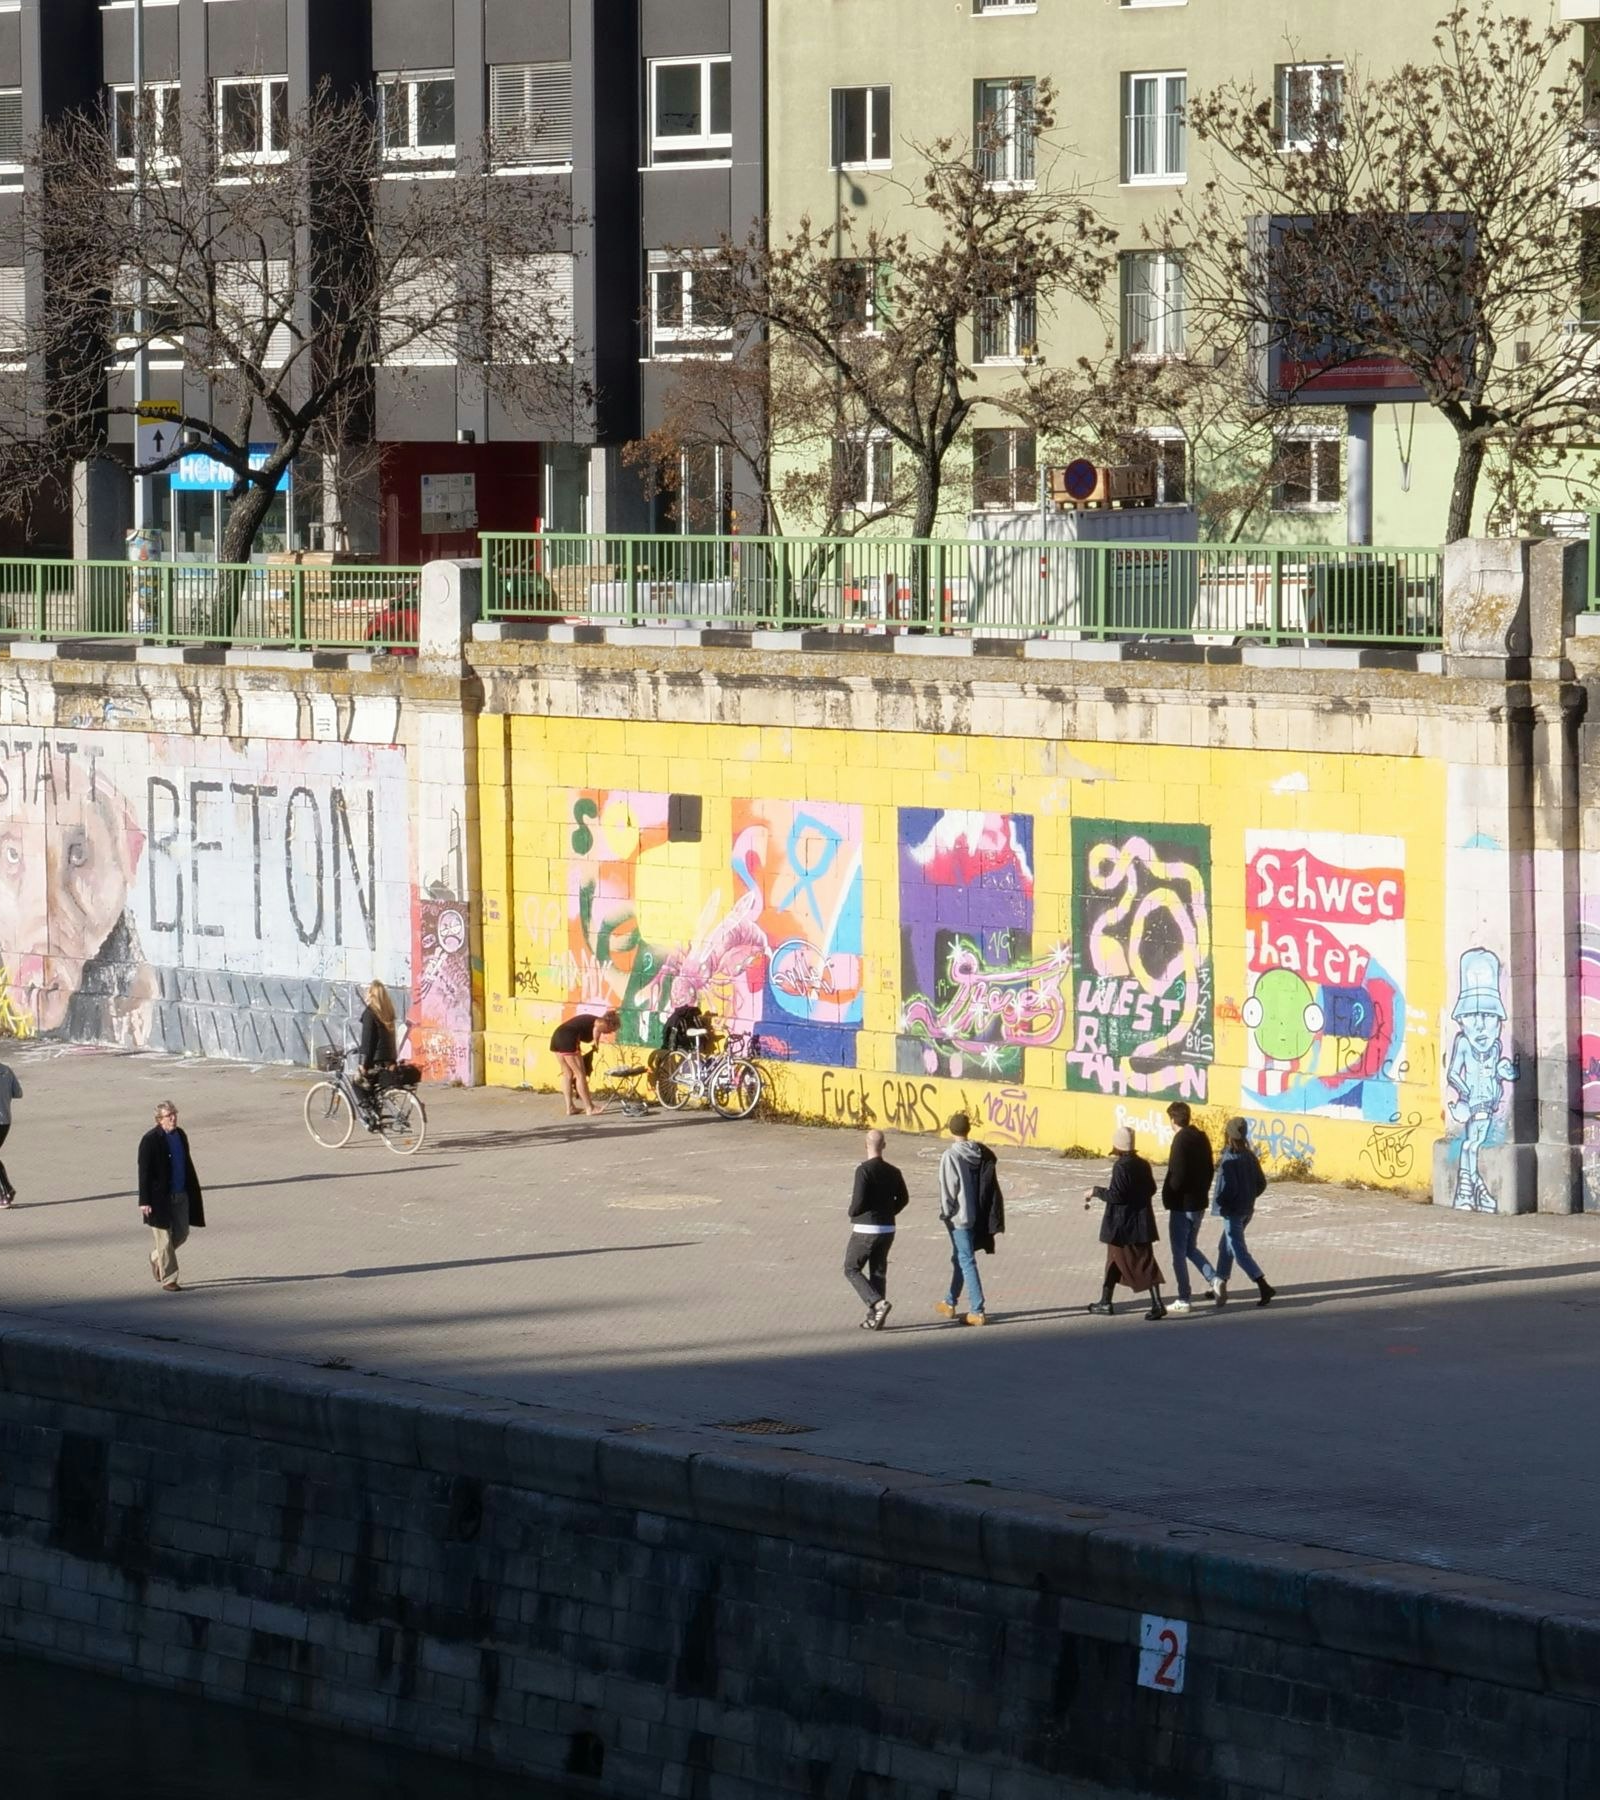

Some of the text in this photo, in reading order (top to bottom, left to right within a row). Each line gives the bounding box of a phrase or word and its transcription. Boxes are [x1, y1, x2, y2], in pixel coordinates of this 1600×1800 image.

[148, 776, 377, 951] BETON
[1256, 854, 1397, 916] Schwec
[1078, 980, 1181, 1031] WEST
[1333, 995, 1392, 1044] Fuk
[882, 1080, 940, 1133] CARS
[1146, 1624, 1179, 1687] 7 2
